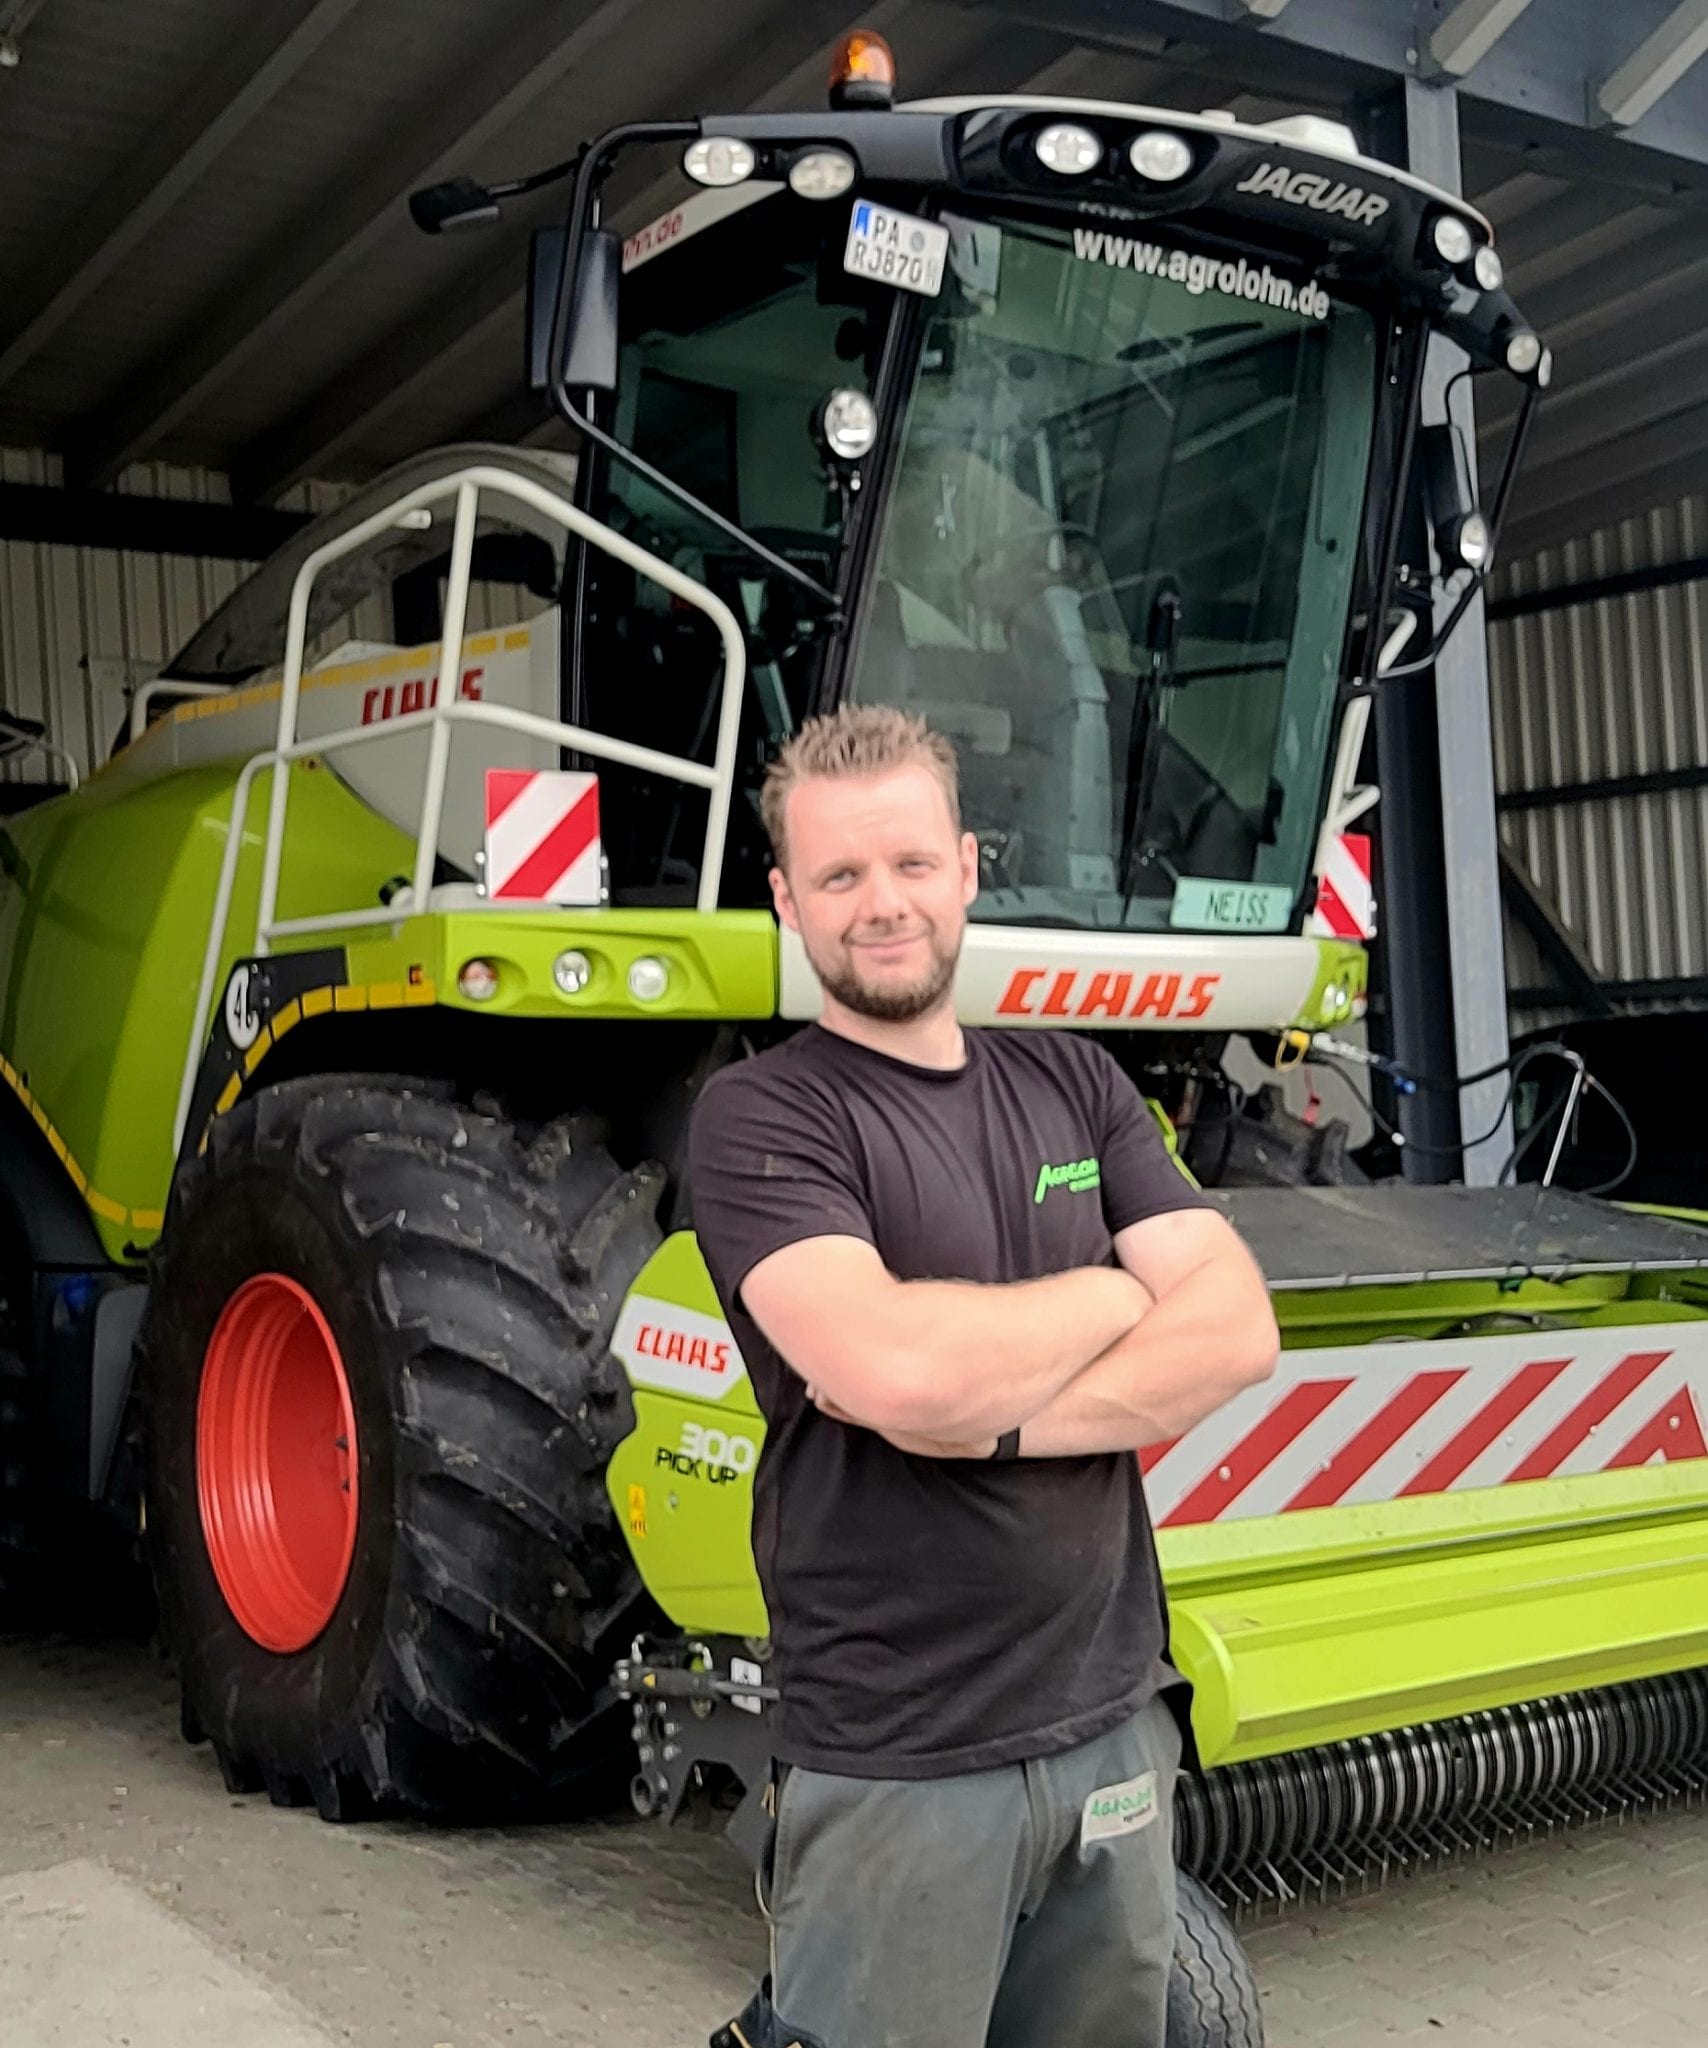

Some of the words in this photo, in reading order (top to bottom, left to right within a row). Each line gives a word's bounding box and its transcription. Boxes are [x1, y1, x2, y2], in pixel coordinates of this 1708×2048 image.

[1236, 162, 1389, 226] JAGUAR
[874, 215, 899, 247] PA
[1073, 228, 1330, 320] www.agrolohn.de
[996, 967, 1221, 1019] CLAAS
[636, 1323, 730, 1375] CLAAS
[655, 1447, 700, 1480] PICK
[707, 1462, 738, 1487] UP
[677, 1420, 755, 1475] 300
